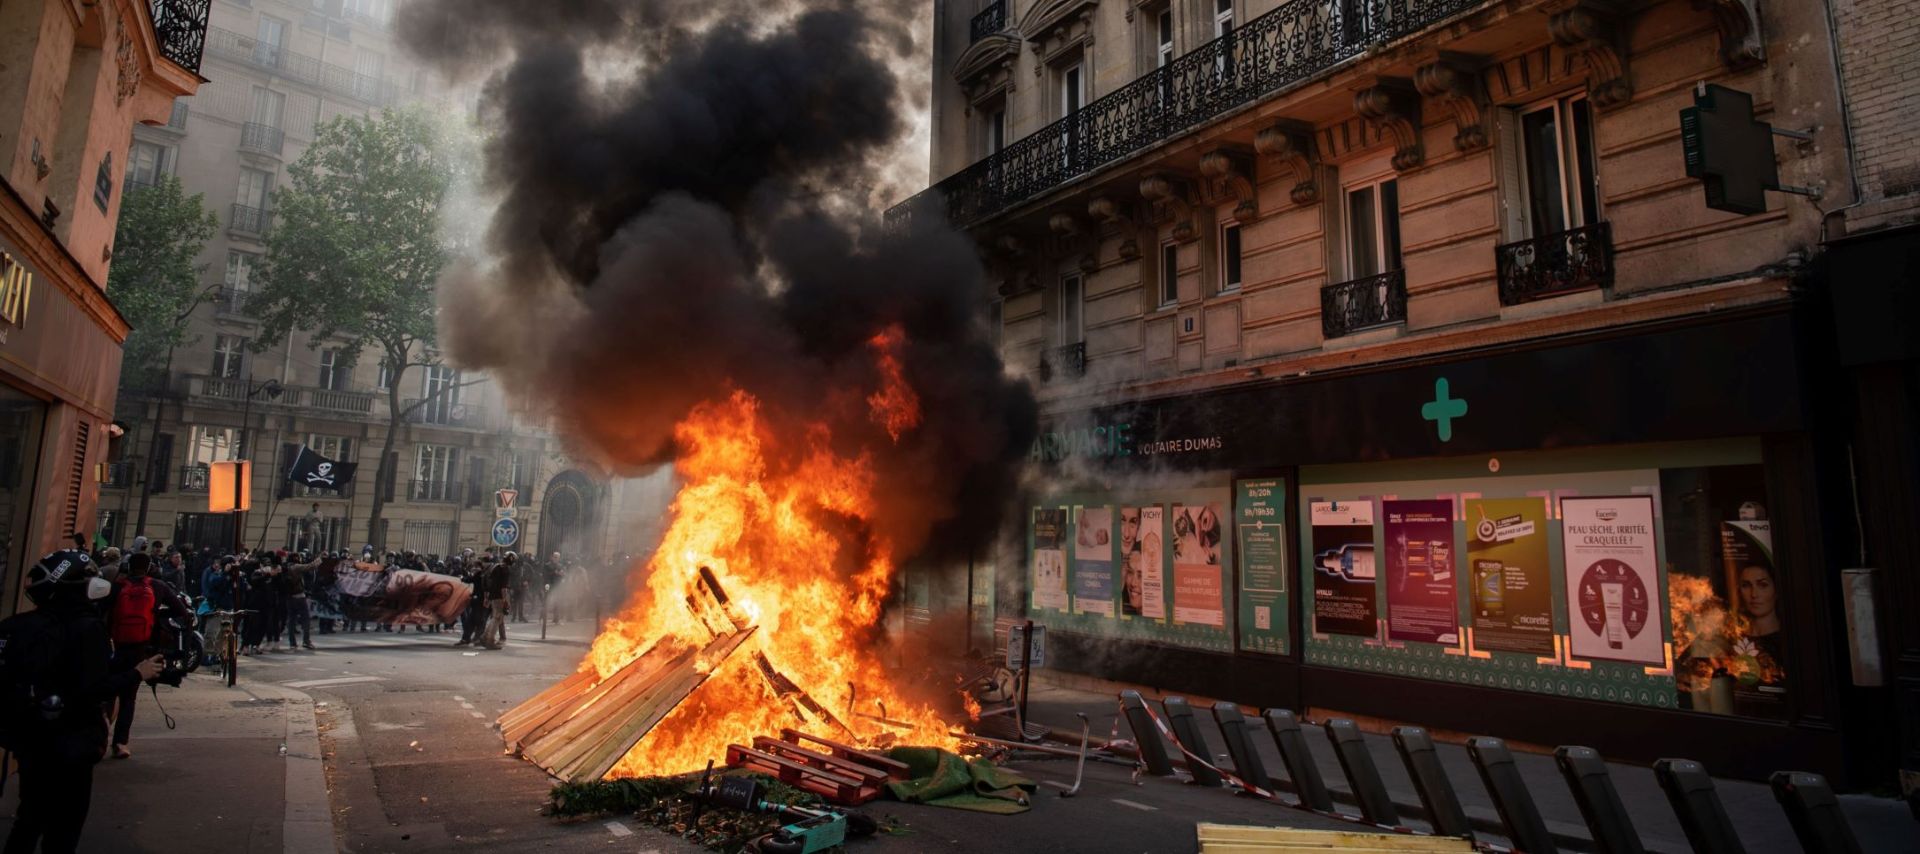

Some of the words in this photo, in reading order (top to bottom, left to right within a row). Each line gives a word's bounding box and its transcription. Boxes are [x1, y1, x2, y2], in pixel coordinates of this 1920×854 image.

[1029, 424, 1131, 463] ARMACIE
[1138, 440, 1182, 455] VOLTAIRE
[1185, 437, 1222, 451] DUMAS
[1143, 511, 1160, 519] VICHY
[1596, 510, 1618, 518] Eucerin
[1568, 526, 1587, 534] PEAU
[1589, 524, 1615, 535] SÈCHE,
[1617, 523, 1648, 535] IRRITÉE,
[1583, 534, 1628, 546] CRAQUELÉE
[1520, 615, 1550, 625] nicorette
